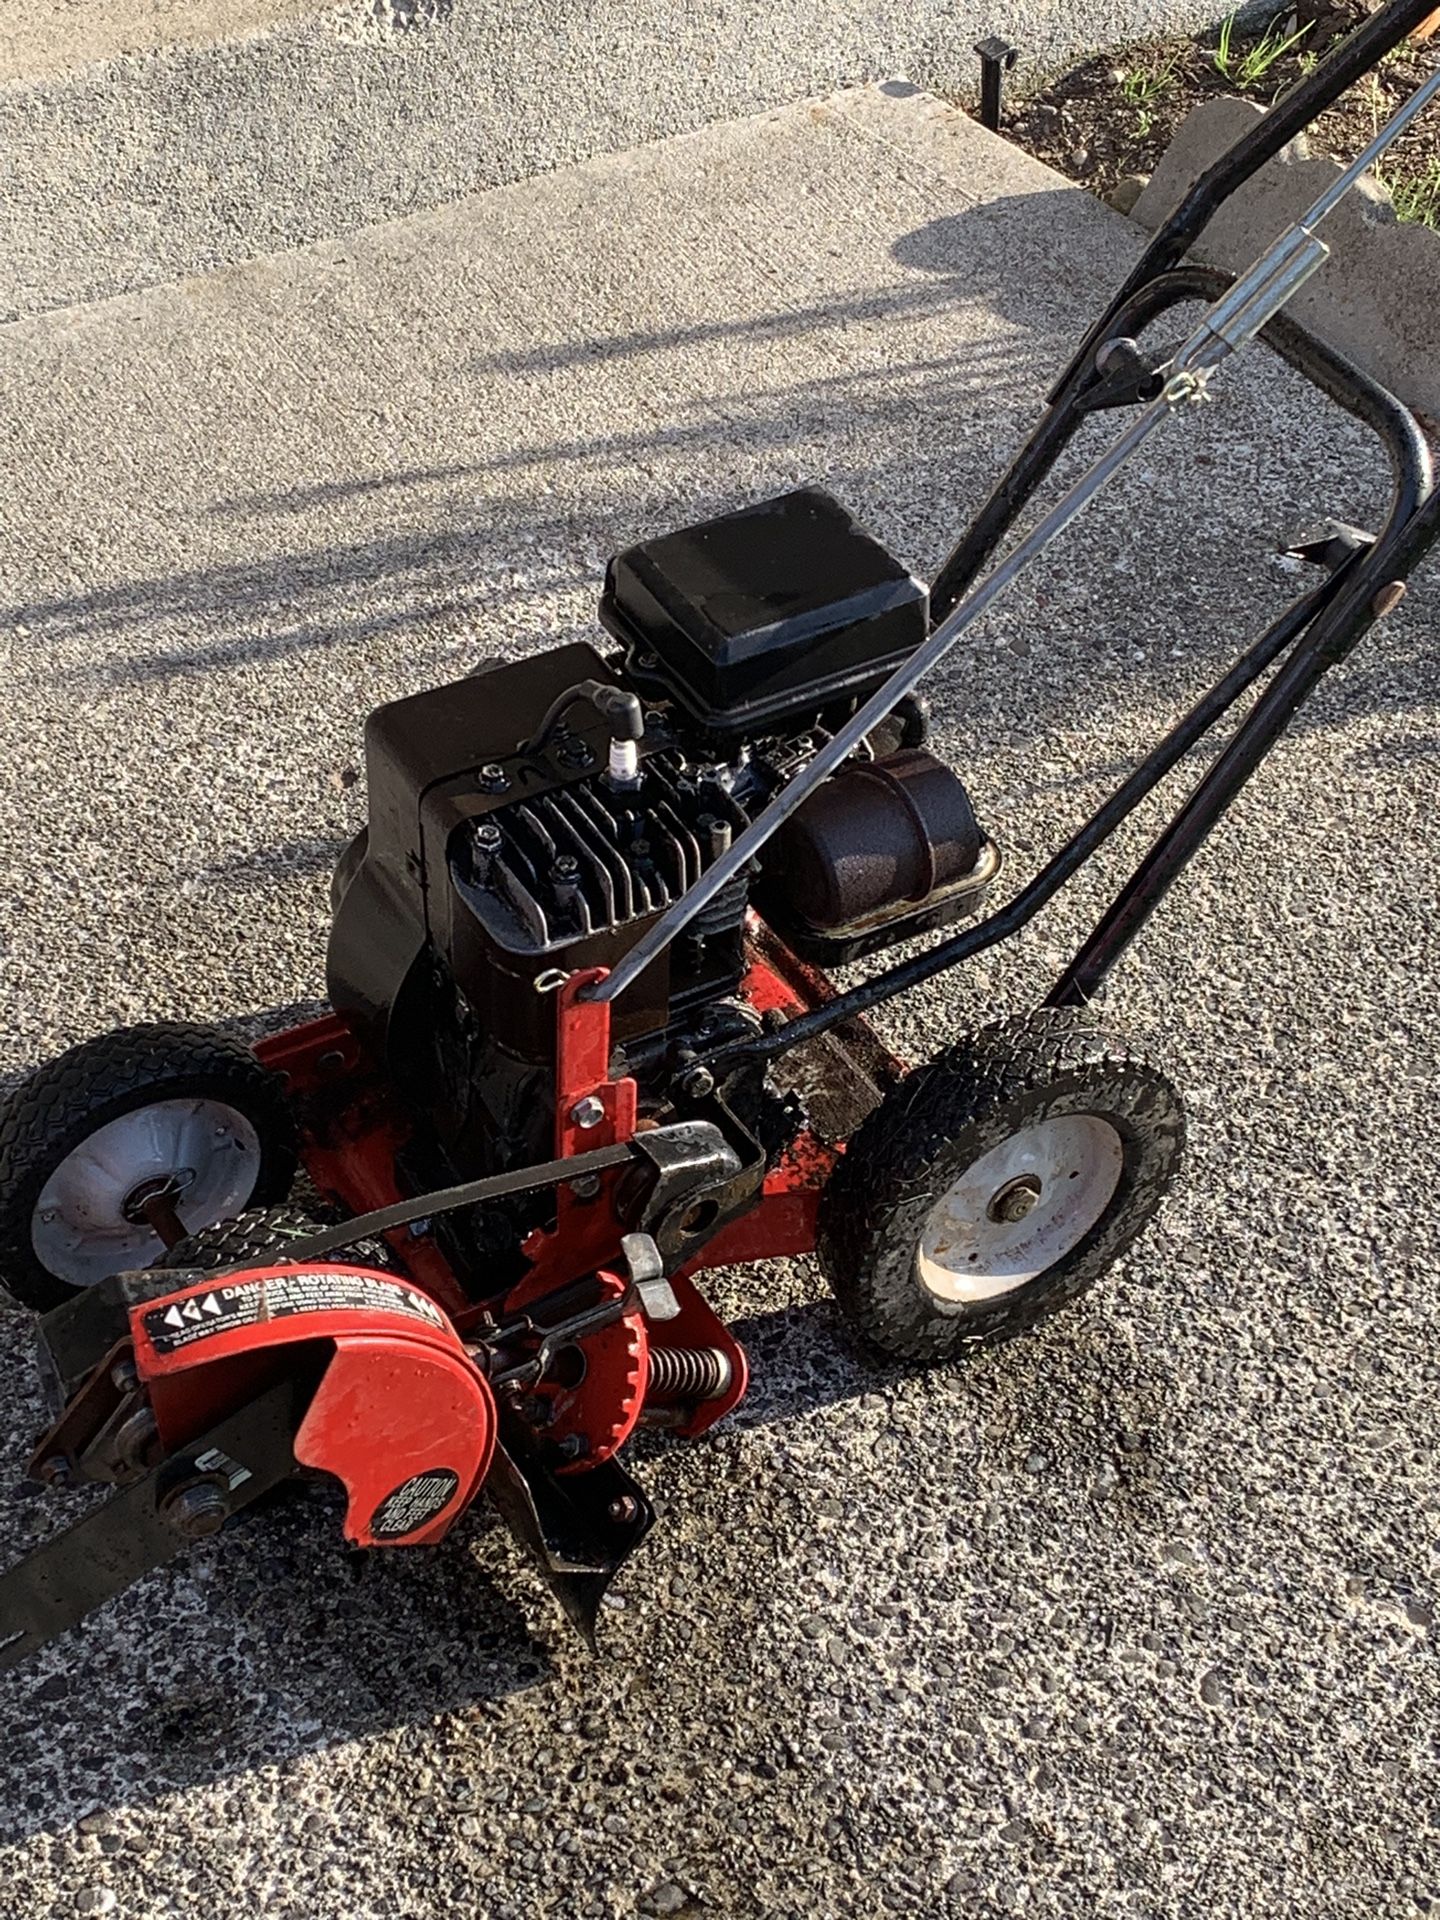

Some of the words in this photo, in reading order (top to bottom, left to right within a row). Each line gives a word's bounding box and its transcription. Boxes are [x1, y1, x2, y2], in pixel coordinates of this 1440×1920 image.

[297, 1275, 363, 1286] ROTATING
[400, 1477, 457, 1497] CAUTION
[384, 1496, 413, 1508] KEEP
[409, 1497, 446, 1510] HANDS
[381, 1508, 407, 1520] AND
[402, 1508, 431, 1520] FEET
[380, 1520, 414, 1532] CLEAR
